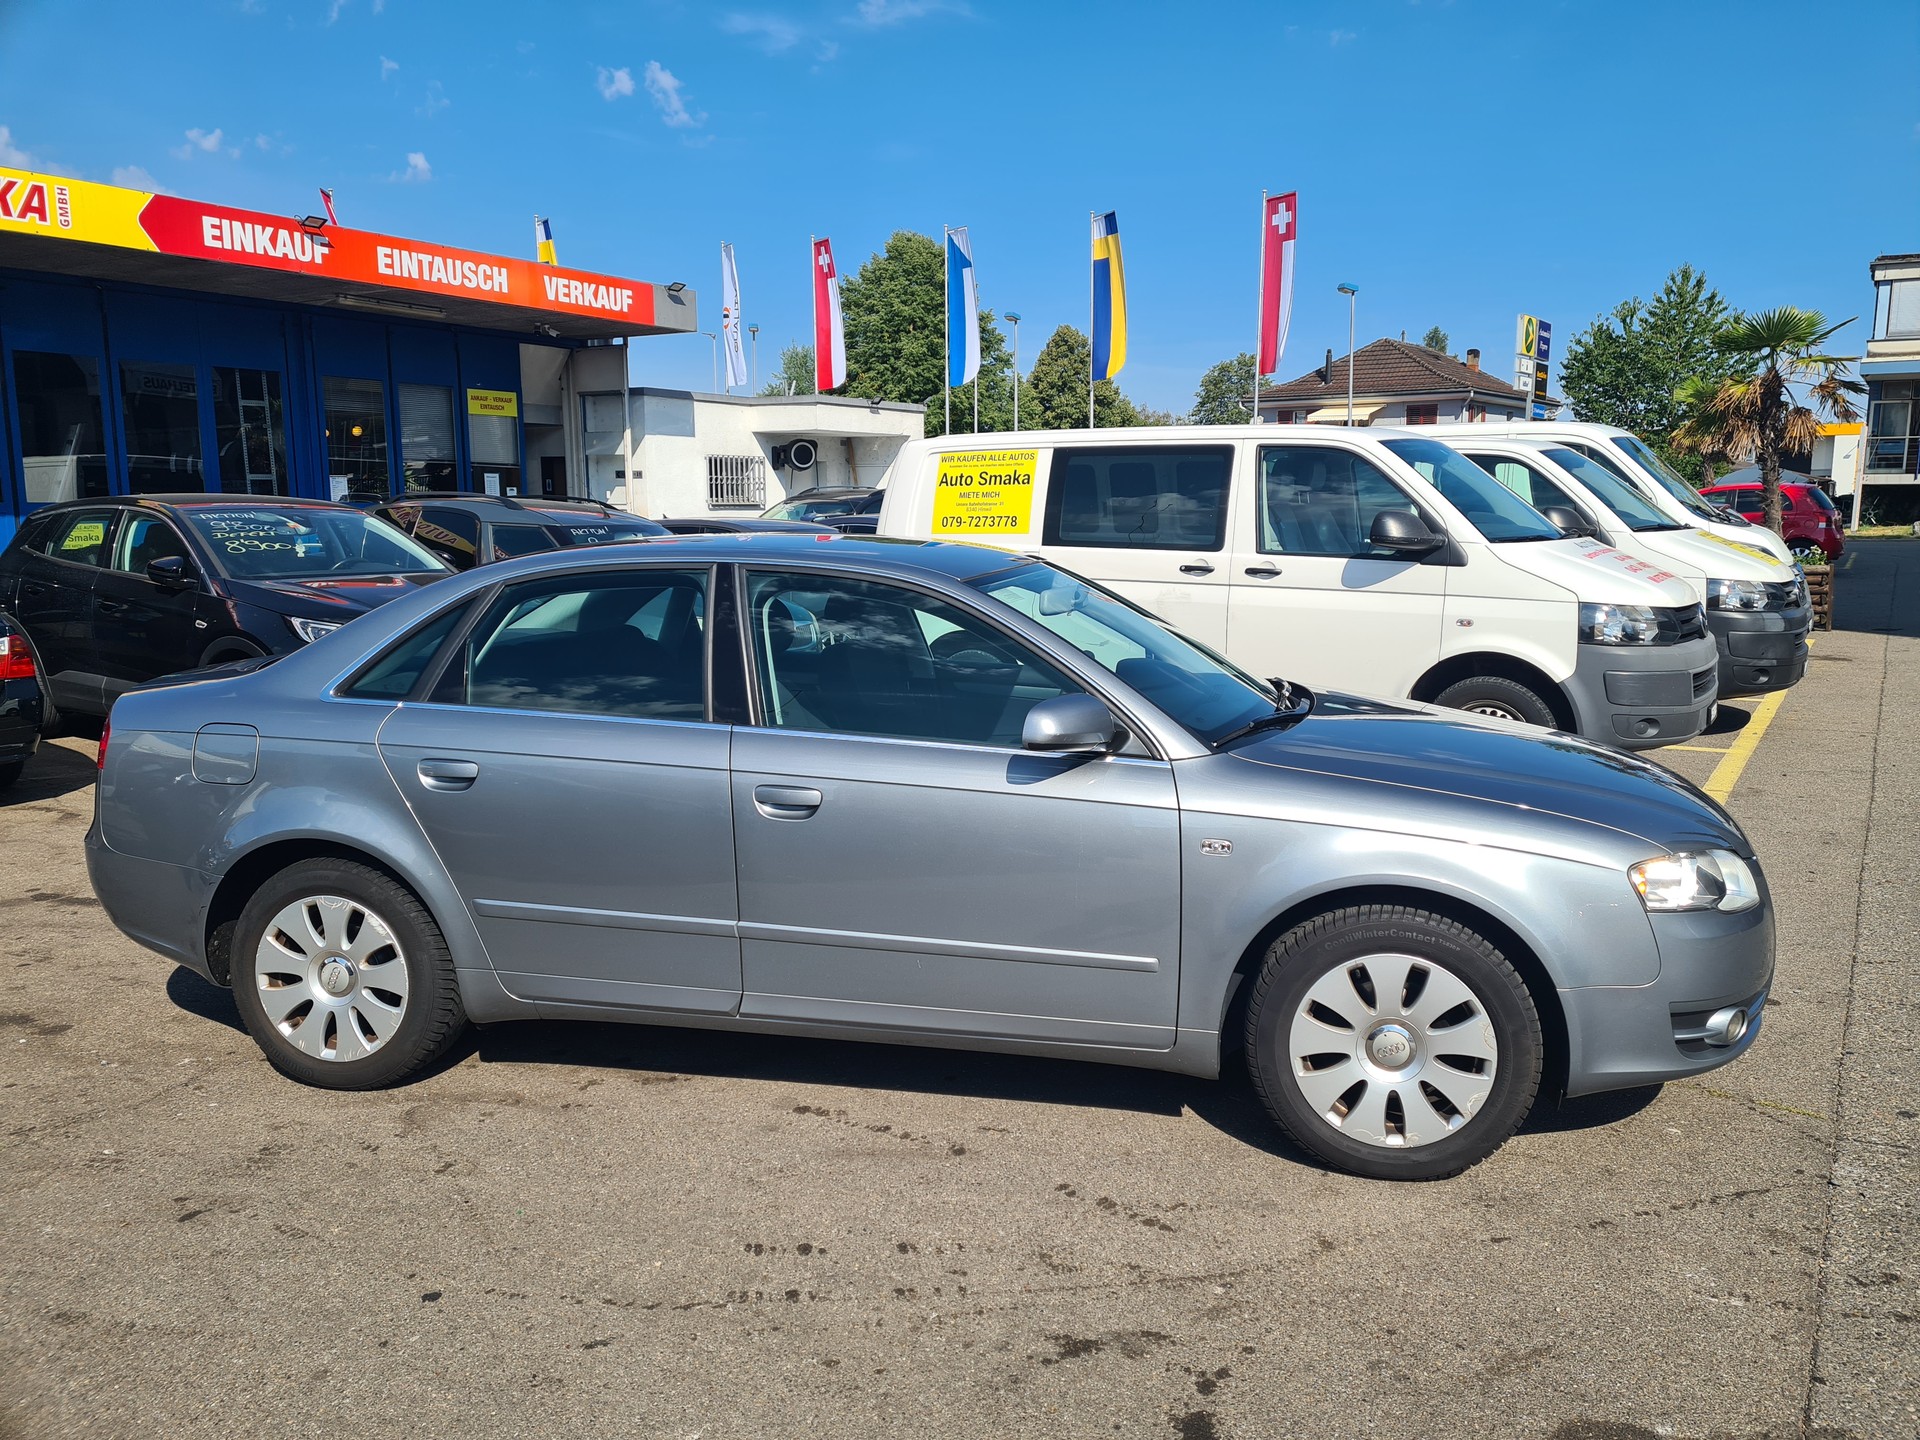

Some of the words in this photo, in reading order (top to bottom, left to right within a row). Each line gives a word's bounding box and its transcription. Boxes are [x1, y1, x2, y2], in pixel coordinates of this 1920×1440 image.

[58, 186, 69, 228] GMBH
[202, 215, 329, 264] EINKAUF
[377, 246, 509, 293] EINTAUSCH
[543, 274, 633, 313] VERKAUF
[470, 394, 489, 402] ANKAUF
[492, 396, 513, 404] VERKAUF
[479, 403, 505, 411] EINTAUSCH
[941, 455, 955, 463] WIR
[956, 454, 987, 463] KAUFEN
[988, 453, 1007, 462] ALLE
[1009, 452, 1035, 461] AUTOS
[939, 472, 974, 487] Auto
[978, 469, 1031, 486] Smaka
[959, 491, 980, 499] MIETE
[981, 491, 1000, 499] MICH
[941, 515, 1018, 528] 079-7273778
[68, 533, 100, 542] Smaka
[1324, 928, 1436, 950] ContiWinterContact
